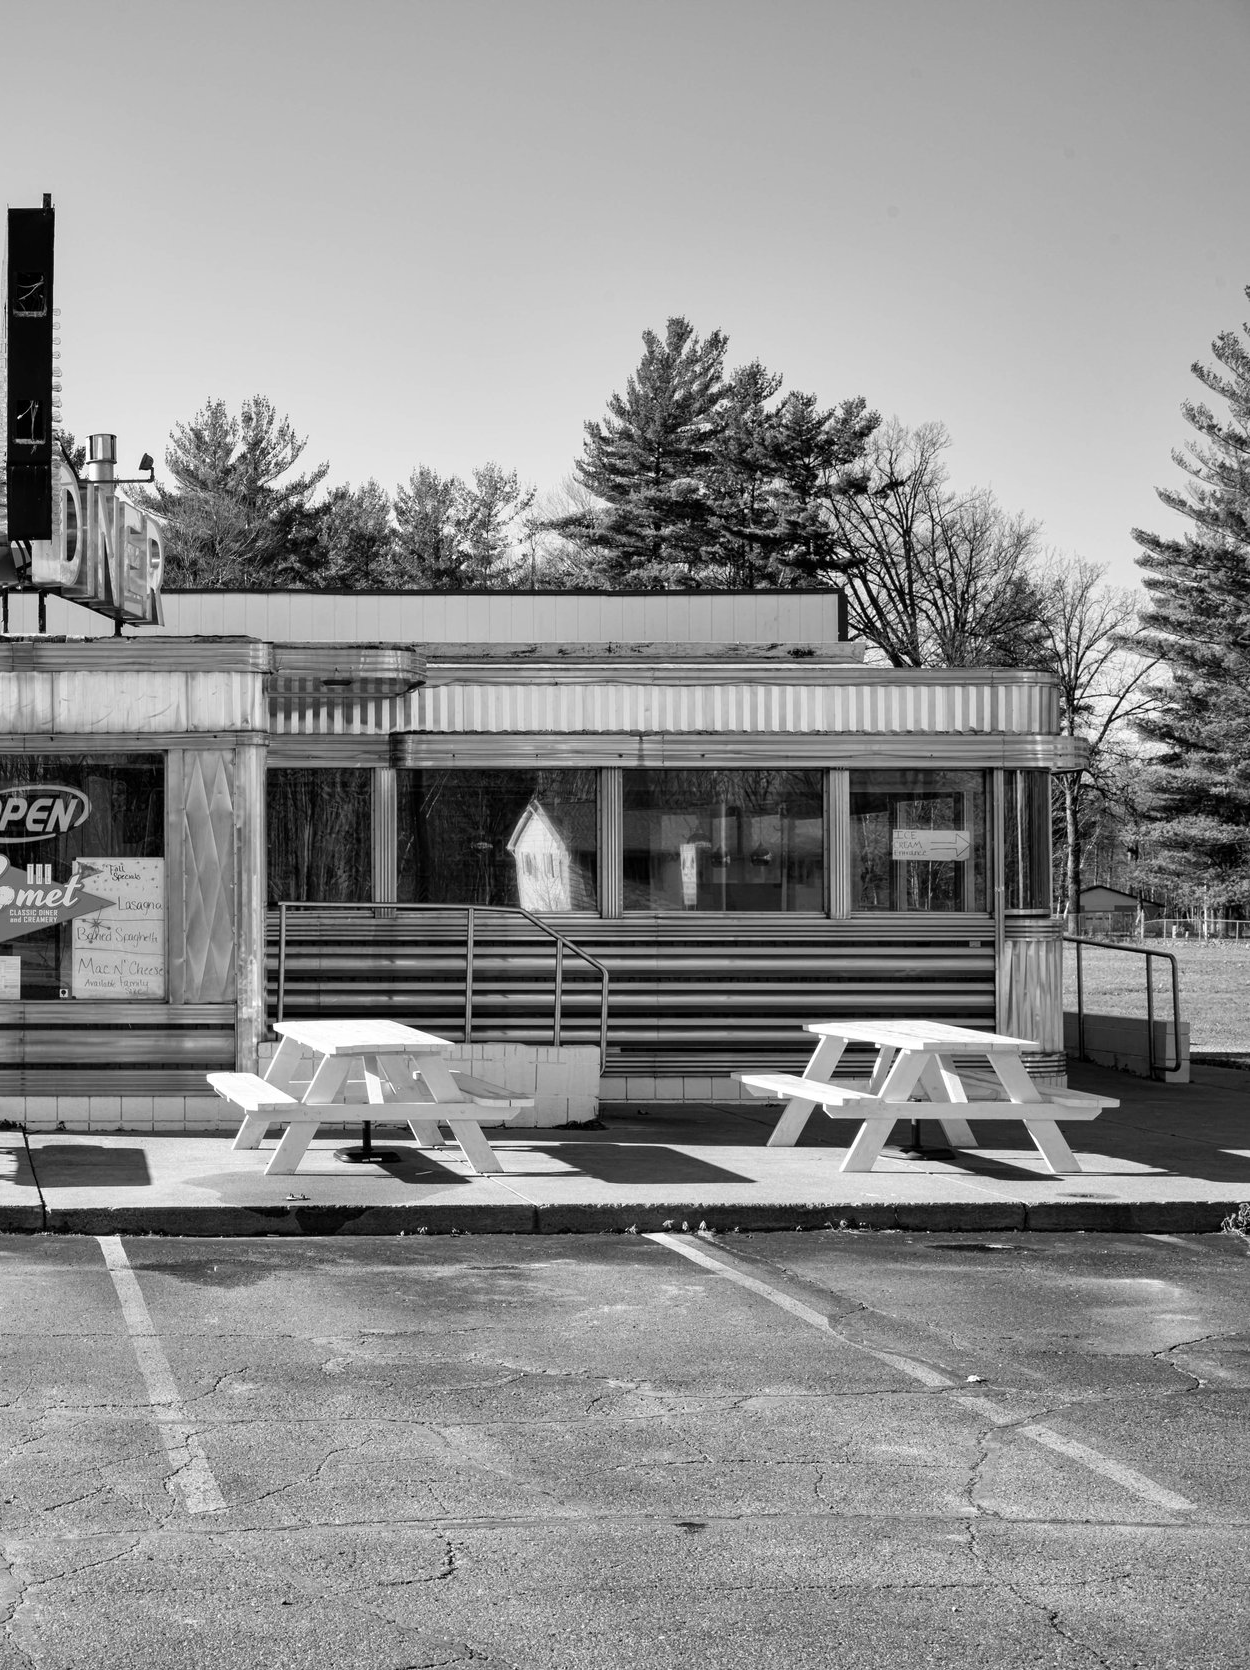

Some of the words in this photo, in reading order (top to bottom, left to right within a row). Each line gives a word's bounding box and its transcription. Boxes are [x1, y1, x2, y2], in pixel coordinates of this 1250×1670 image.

[52, 461, 166, 627] DINER
[893, 830, 918, 840] ICE
[893, 841, 923, 849] CREAM
[117, 896, 163, 916] Lasagna
[78, 957, 111, 975] Mac
[129, 960, 165, 977] Cheese
